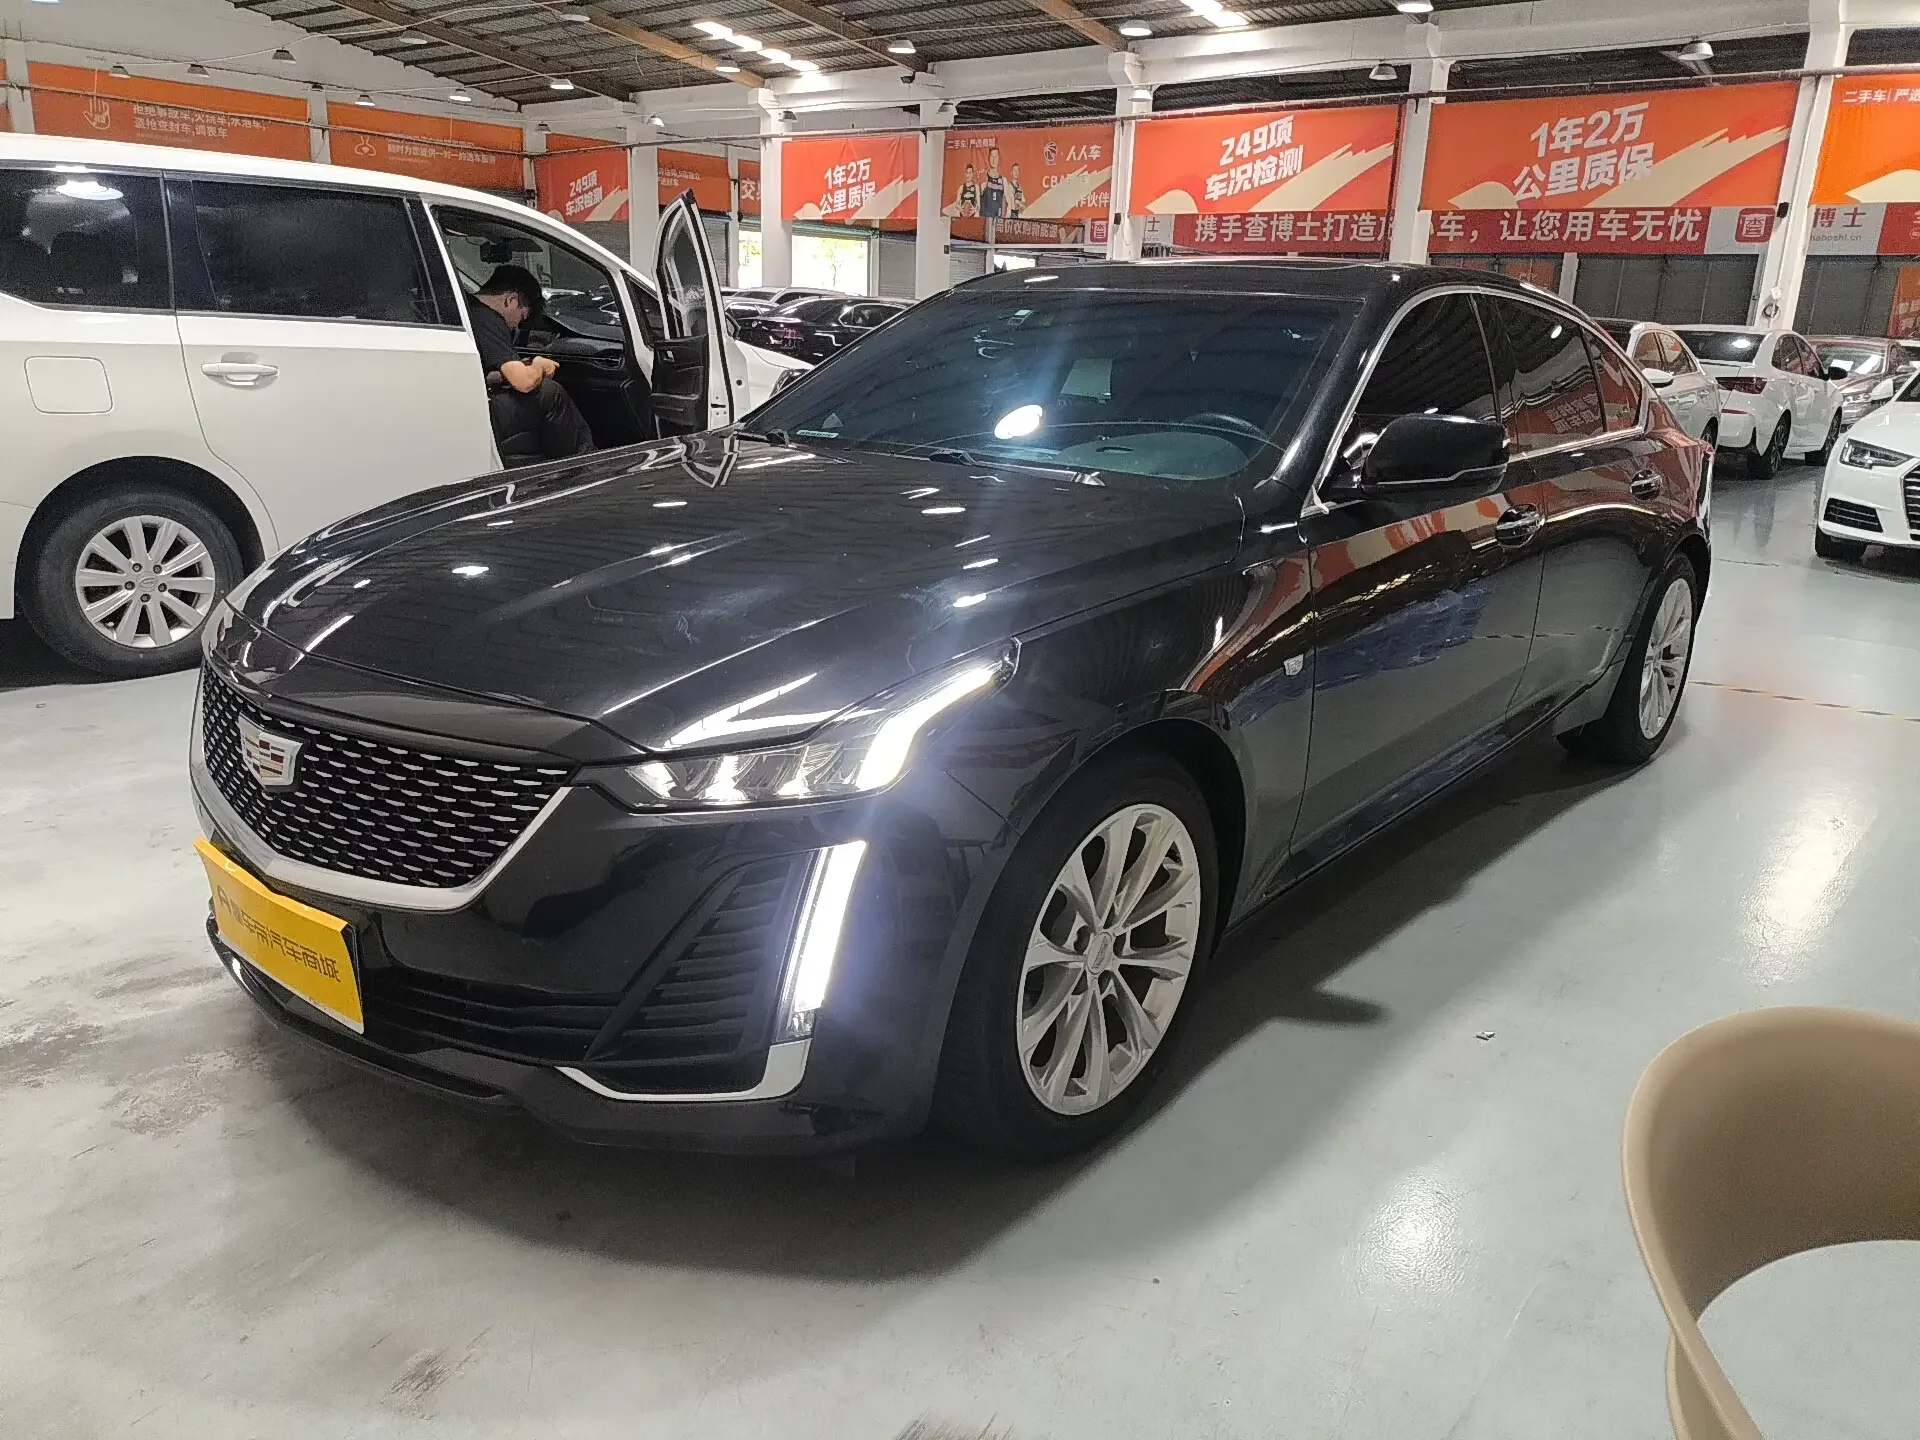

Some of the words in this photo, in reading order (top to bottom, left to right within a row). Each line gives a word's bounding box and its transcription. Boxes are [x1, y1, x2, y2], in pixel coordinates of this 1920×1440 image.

[1219, 115, 1294, 167] 249项
[1530, 102, 1649, 158] 1年2万
[1066, 144, 1102, 162] 人人车
[570, 170, 598, 197] 249项
[824, 158, 872, 189] 1年2万
[1204, 145, 1303, 202] 车况检测
[1514, 142, 1655, 200] 公里质保
[566, 186, 603, 216] 车况检测
[819, 181, 876, 215] 公里质保
